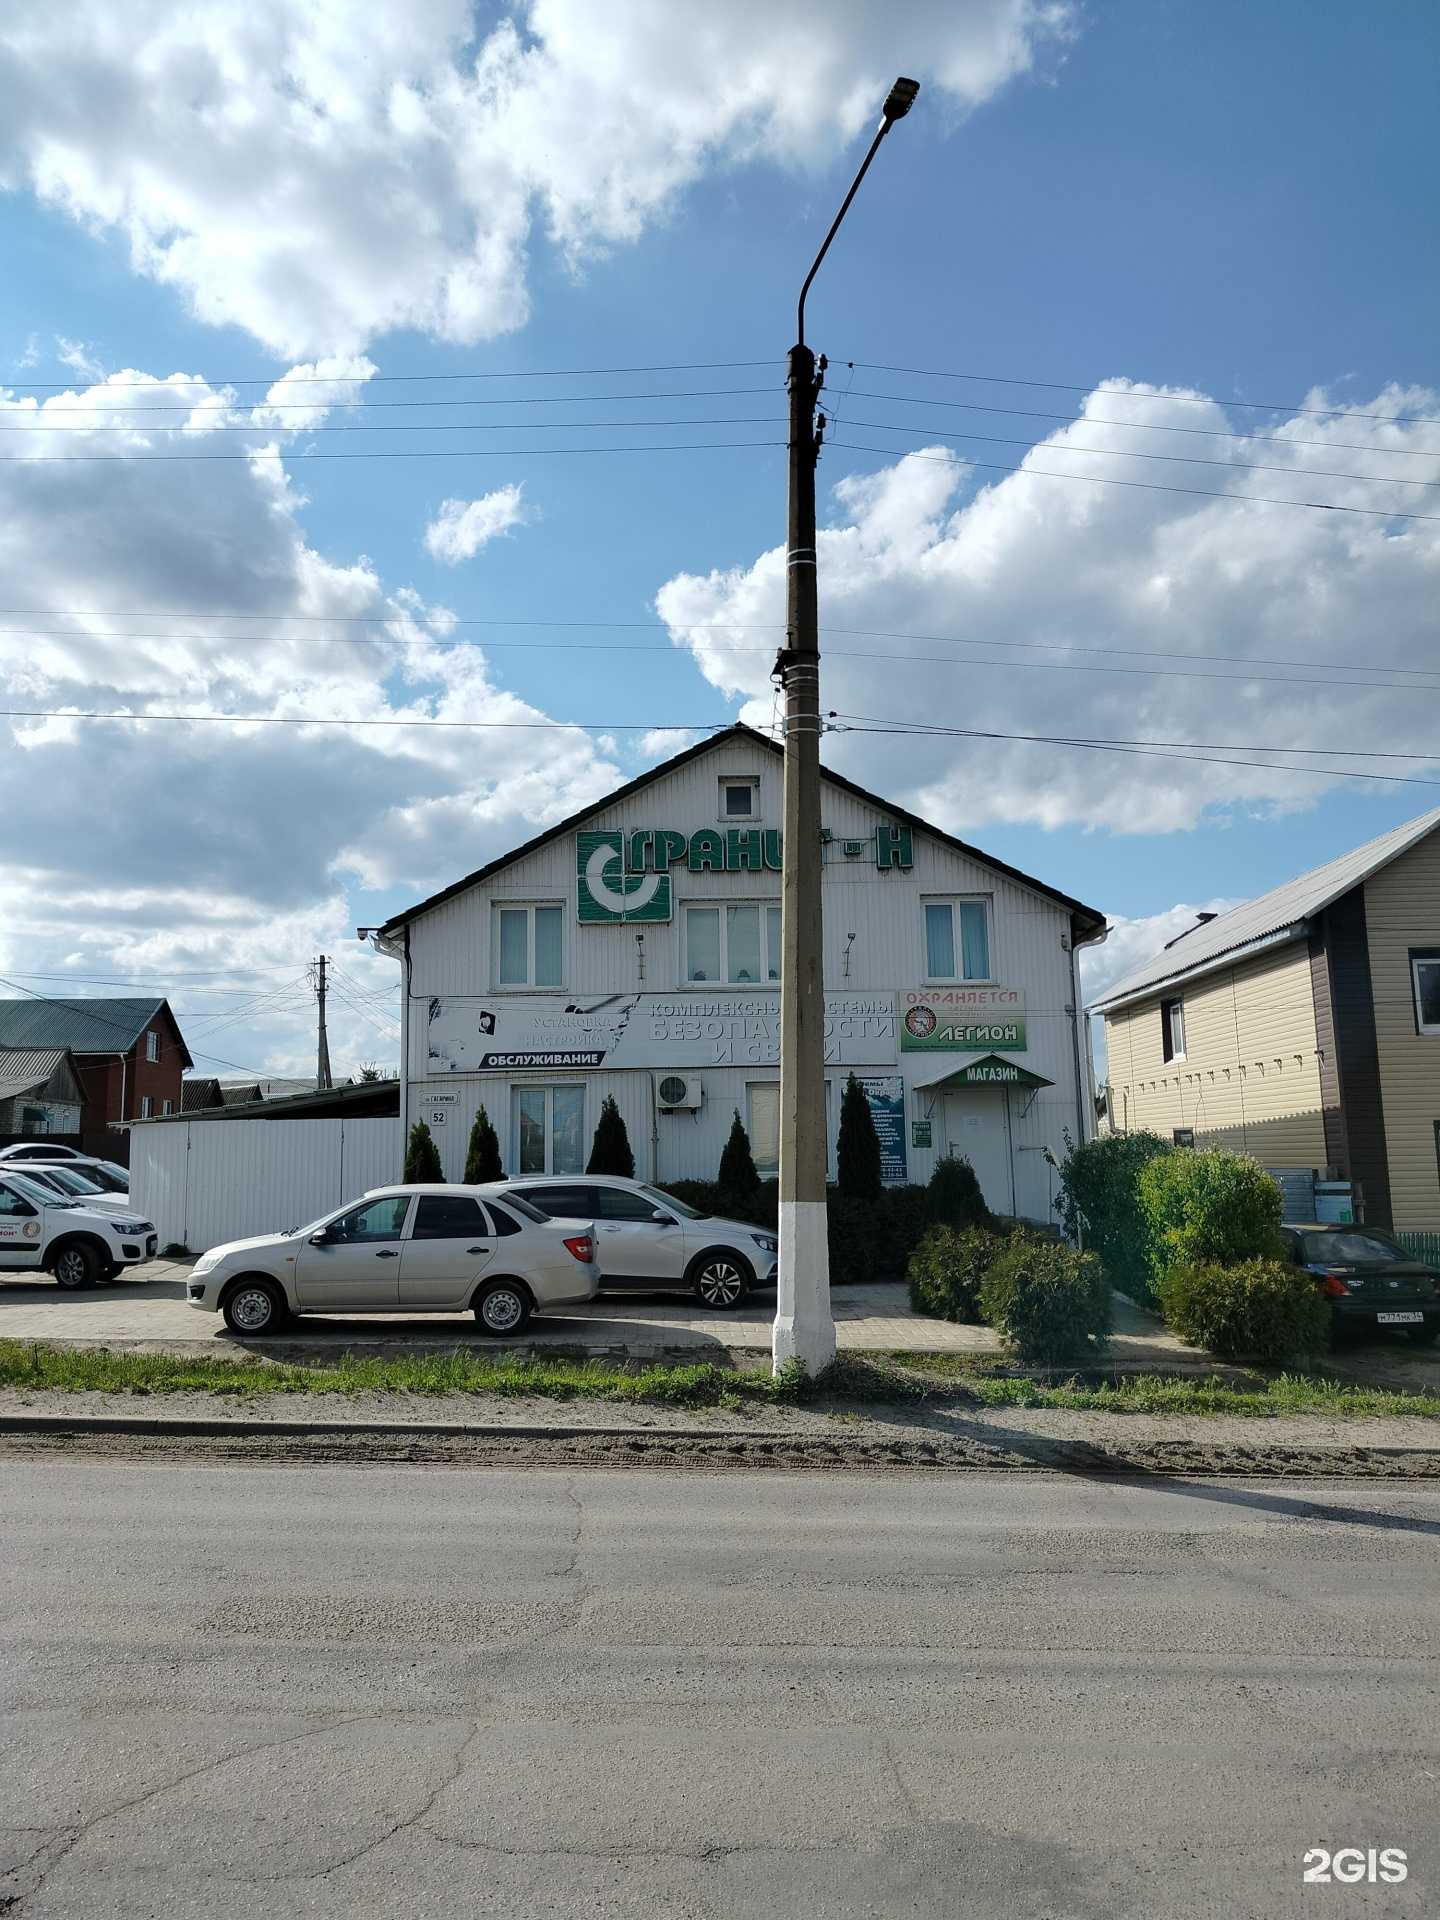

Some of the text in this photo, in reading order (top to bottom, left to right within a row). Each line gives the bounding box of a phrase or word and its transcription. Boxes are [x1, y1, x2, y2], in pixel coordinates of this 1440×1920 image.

[906, 991, 1018, 1004] ОХРАНЯЕТСЯ
[938, 1025, 1018, 1041] ЛЕГИОН
[488, 1053, 599, 1066] ОБСЛУЖИВАНИЕ
[966, 1067, 1018, 1081] МАГАЗИН
[433, 1112, 444, 1122] 52
